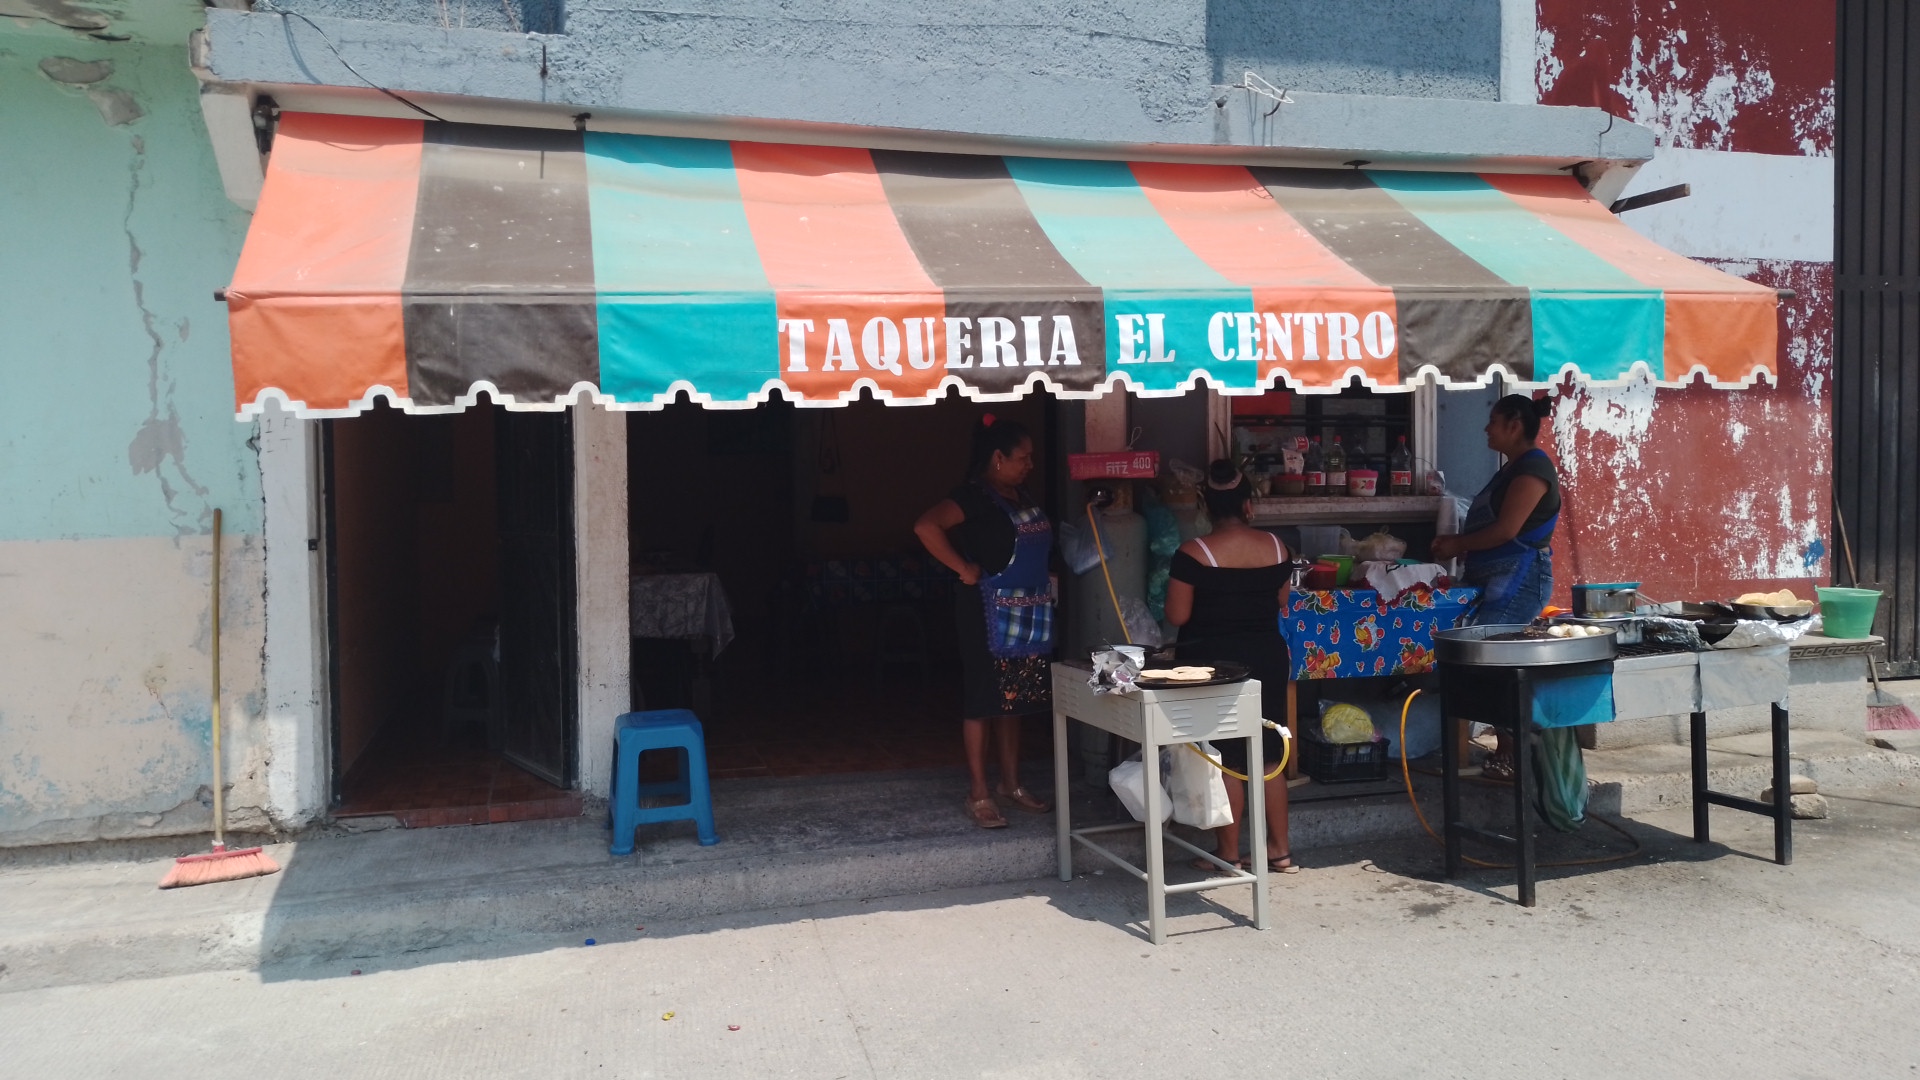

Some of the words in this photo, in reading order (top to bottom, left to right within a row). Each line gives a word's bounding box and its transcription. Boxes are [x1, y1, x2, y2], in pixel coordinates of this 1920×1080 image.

[778, 315, 1082, 376] TAQUERIA
[1114, 313, 1176, 364] EL
[1207, 311, 1396, 362] CENTRO
[1132, 456, 1151, 469] 400
